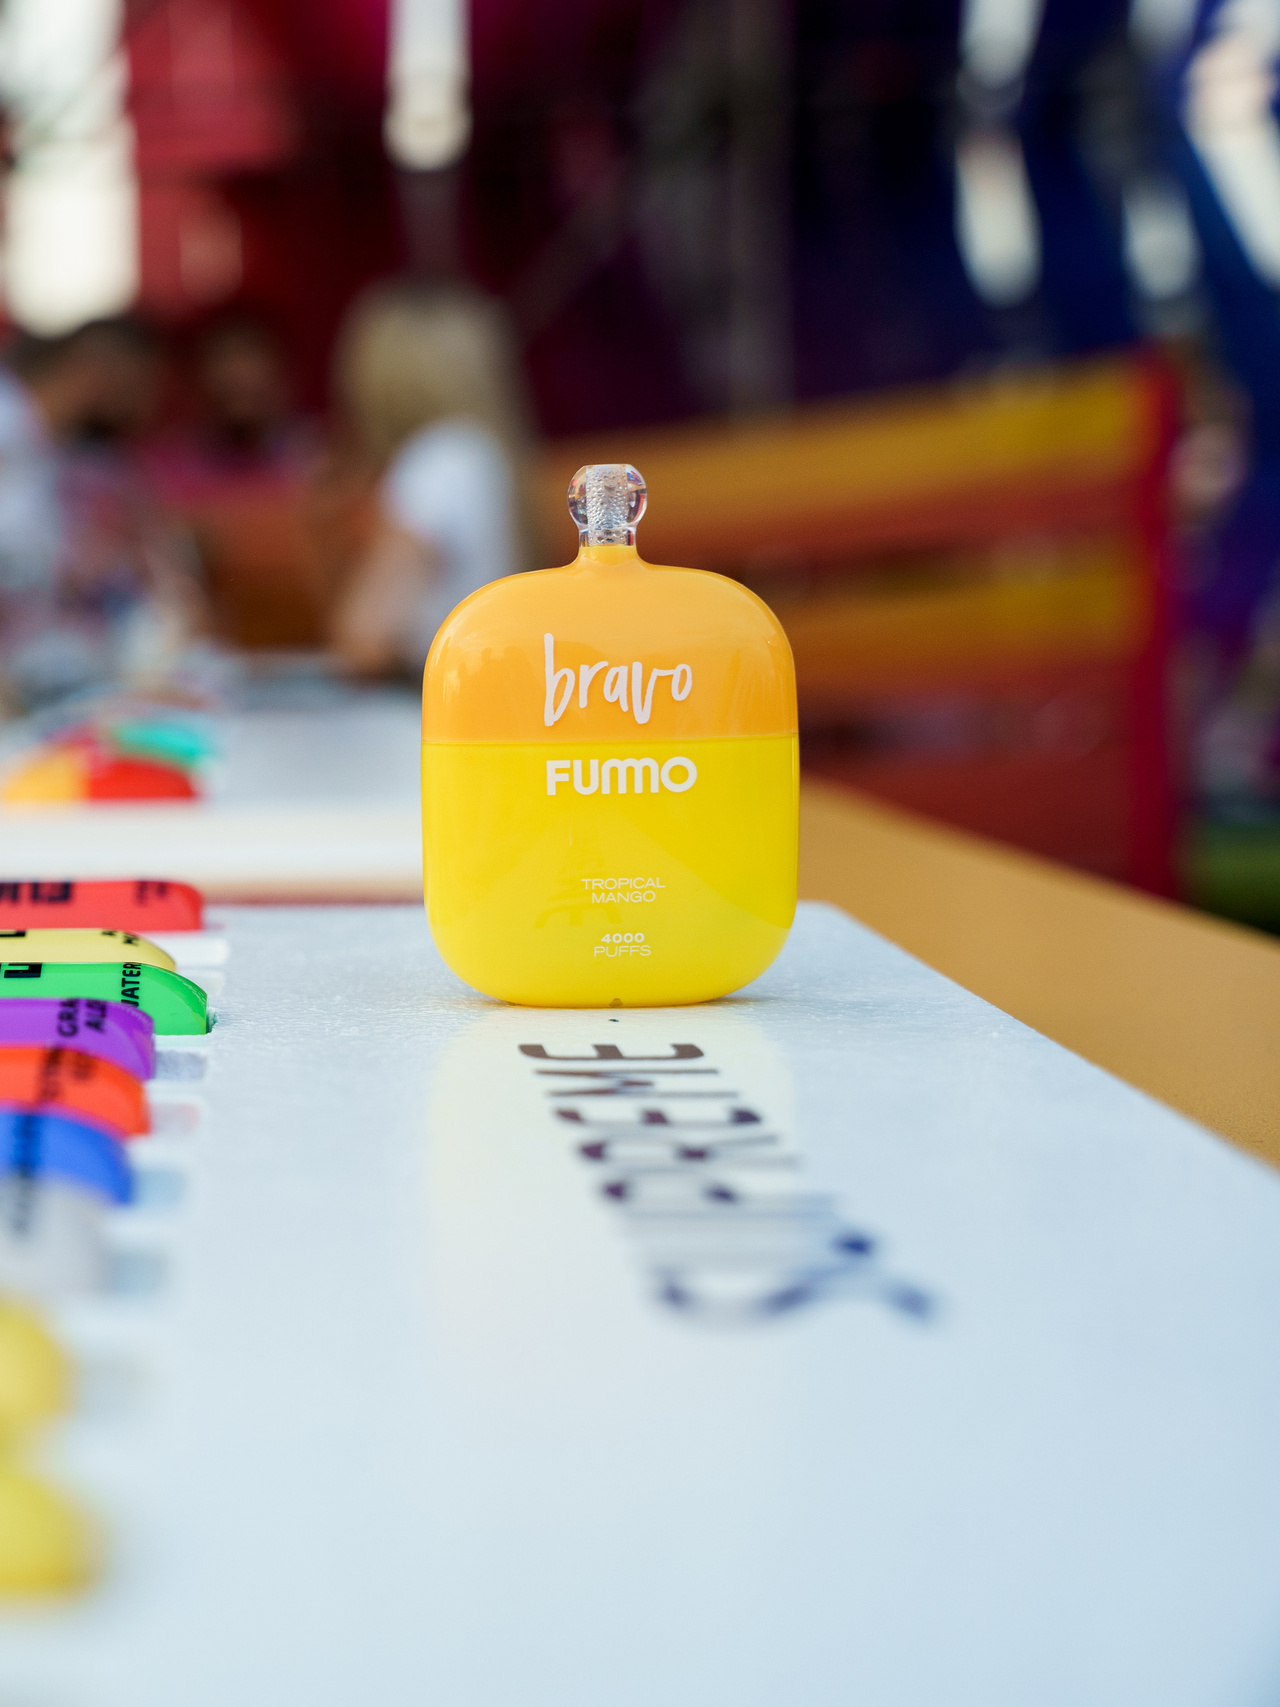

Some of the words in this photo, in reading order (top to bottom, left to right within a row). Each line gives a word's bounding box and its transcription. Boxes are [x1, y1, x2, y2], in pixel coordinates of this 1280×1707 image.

[543, 632, 693, 727] bravo
[546, 756, 698, 796] FUMO
[581, 877, 666, 890] TROPICAL
[591, 890, 656, 903] MANGO
[601, 932, 645, 944] 4000
[593, 945, 651, 958] PUFFS
